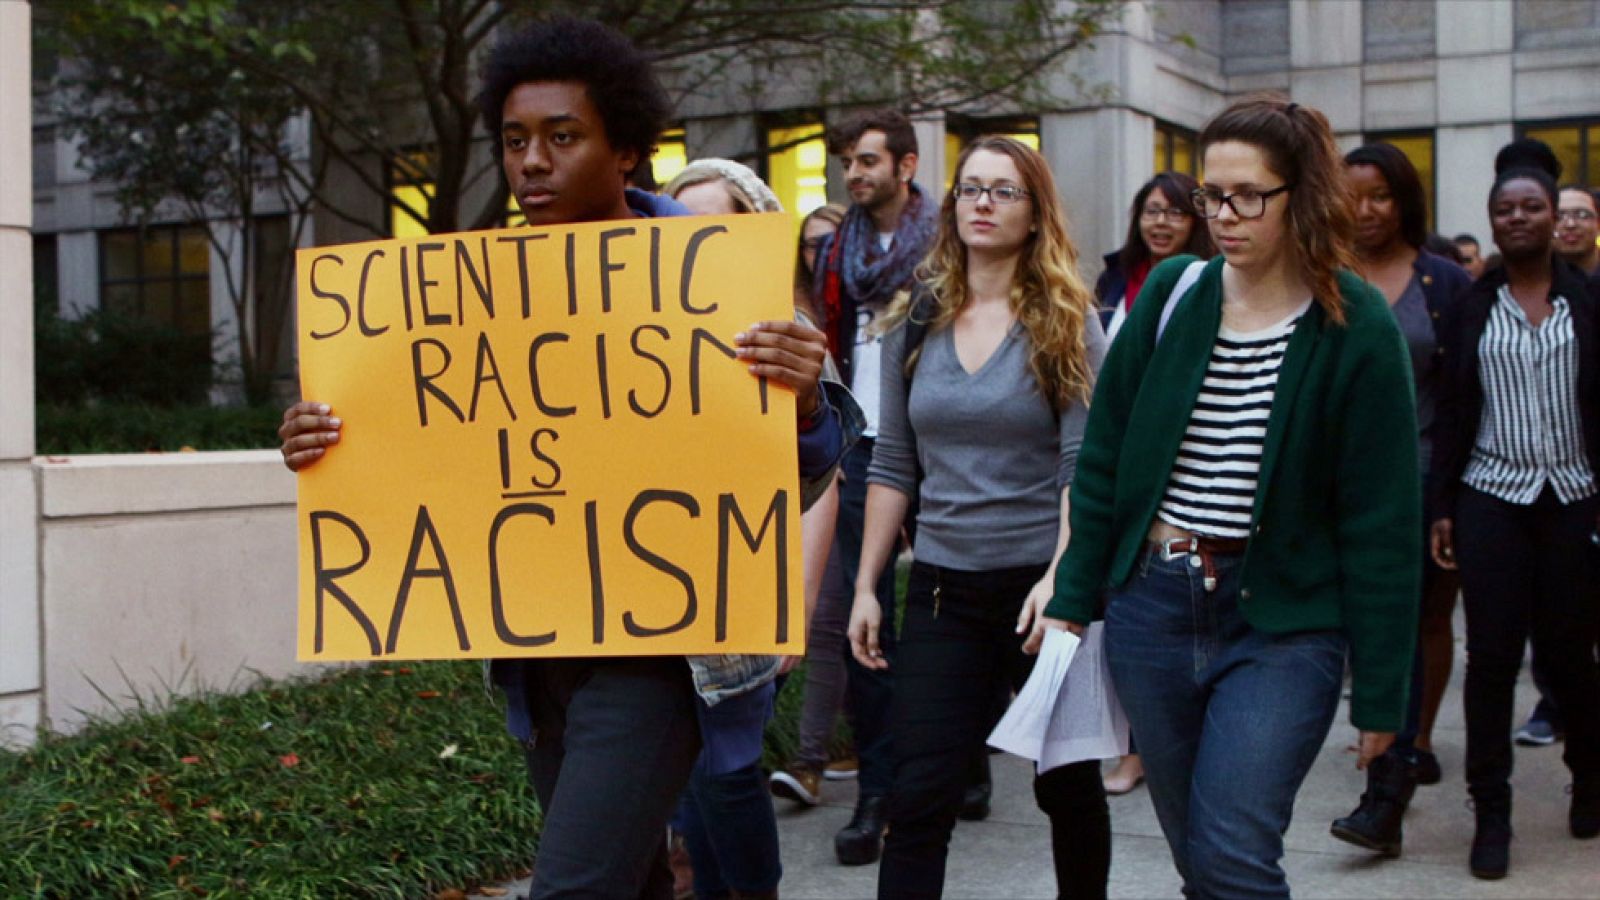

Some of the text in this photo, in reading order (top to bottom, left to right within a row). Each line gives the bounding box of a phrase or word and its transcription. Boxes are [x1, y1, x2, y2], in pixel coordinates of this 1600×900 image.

[310, 225, 727, 339] SCIENTIFIC
[411, 324, 769, 426] RACISM
[497, 428, 561, 490] IS
[309, 489, 788, 656] RACISM
